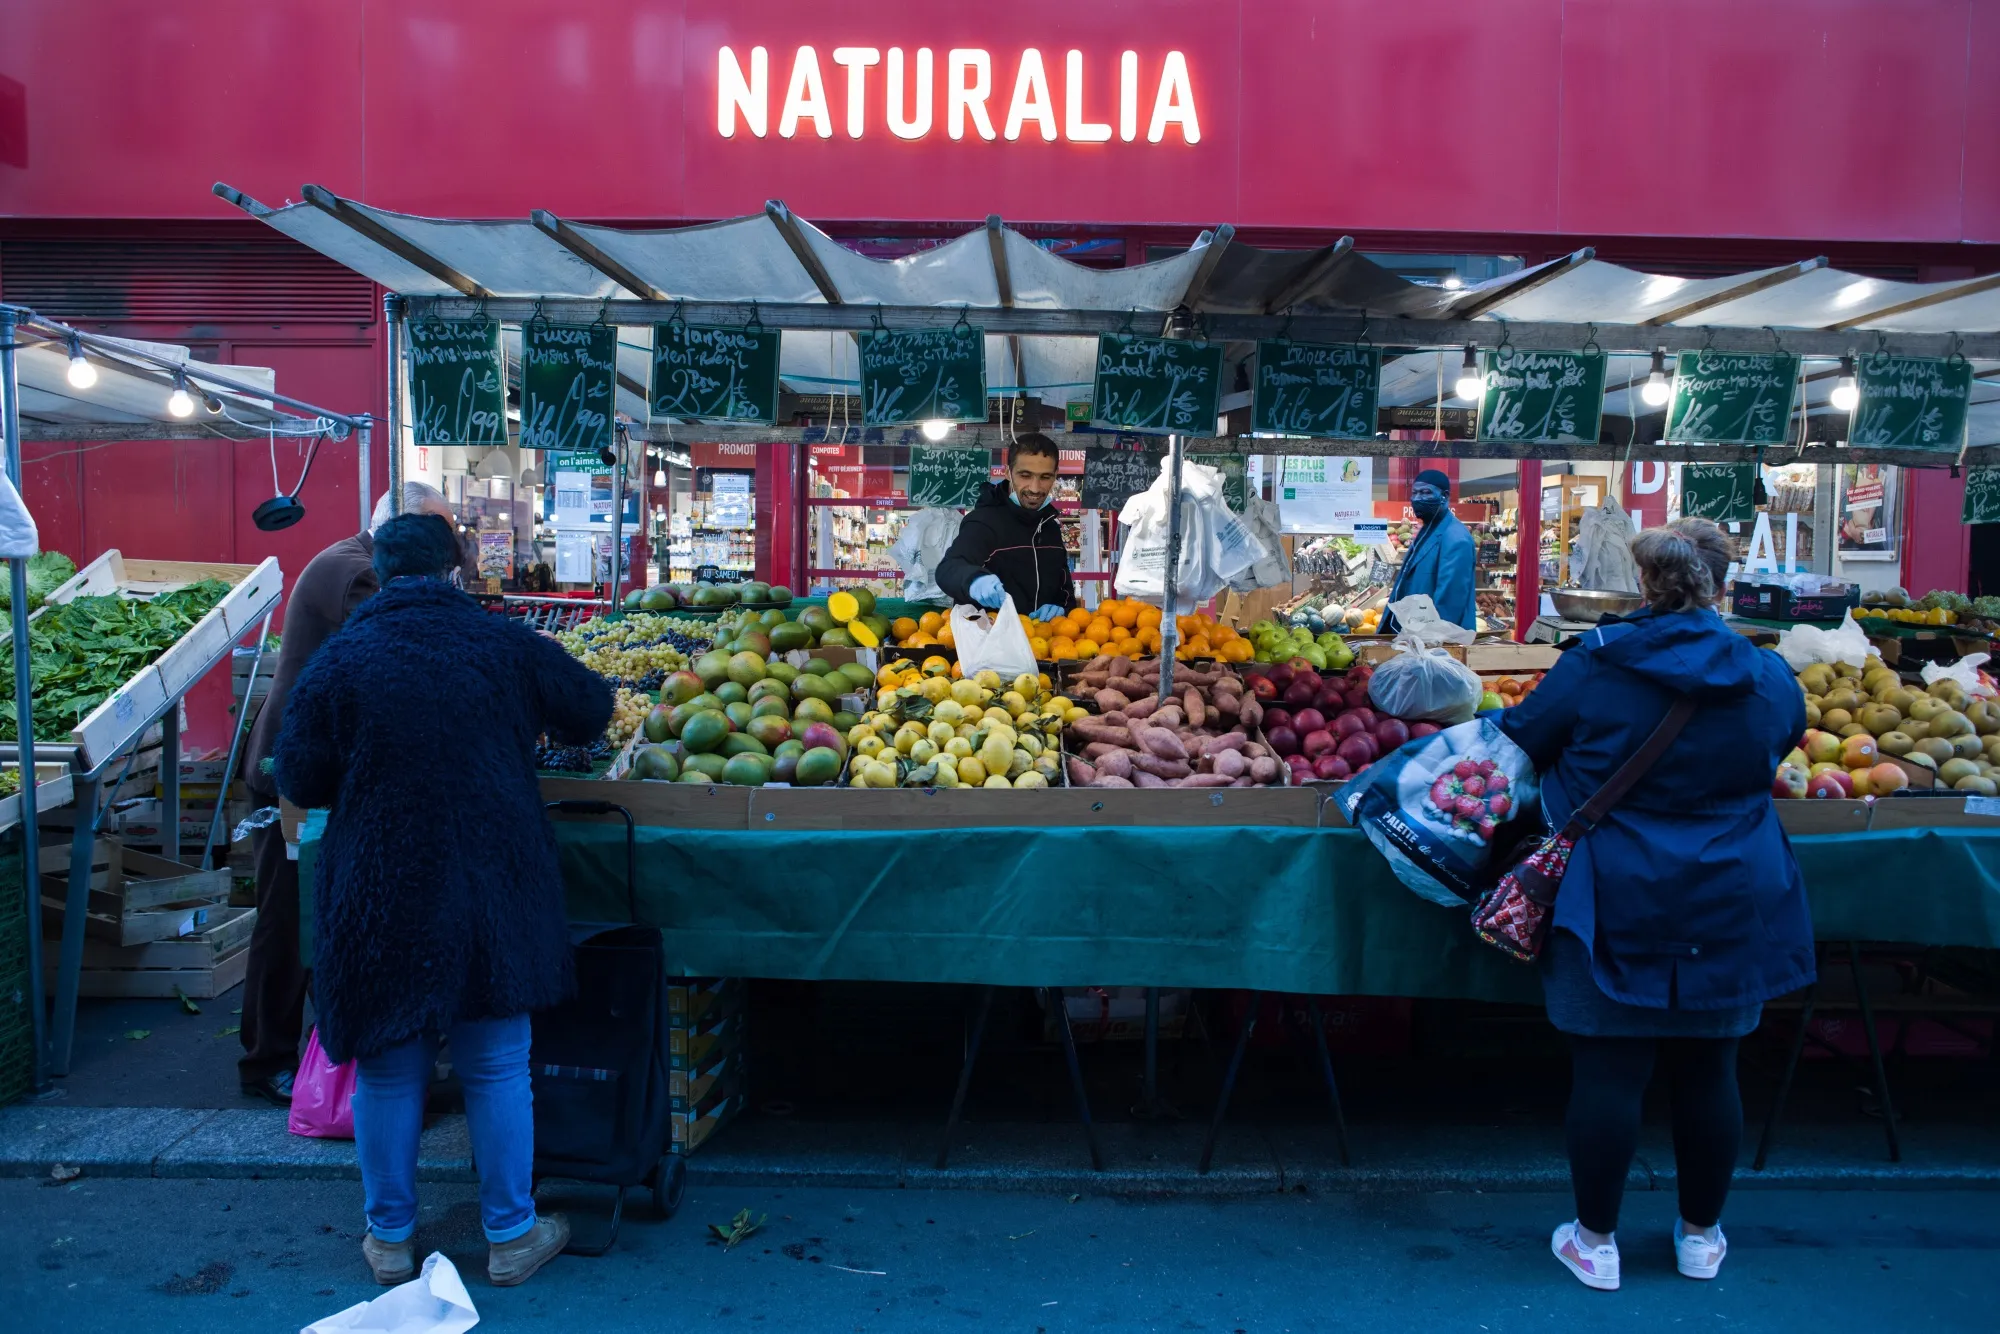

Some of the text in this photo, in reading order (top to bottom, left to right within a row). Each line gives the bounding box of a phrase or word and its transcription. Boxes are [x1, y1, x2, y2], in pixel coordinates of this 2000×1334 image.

[718, 45, 1201, 145] NATURALIA
[812, 447, 840, 455] COMPOTES
[570, 456, 595, 466] l'aime
[1301, 458, 1325, 470] PLUS
[715, 570, 740, 580] SAMEDI
[877, 569, 896, 578] ENTRÉE
[1382, 811, 1419, 843] PALETTE
